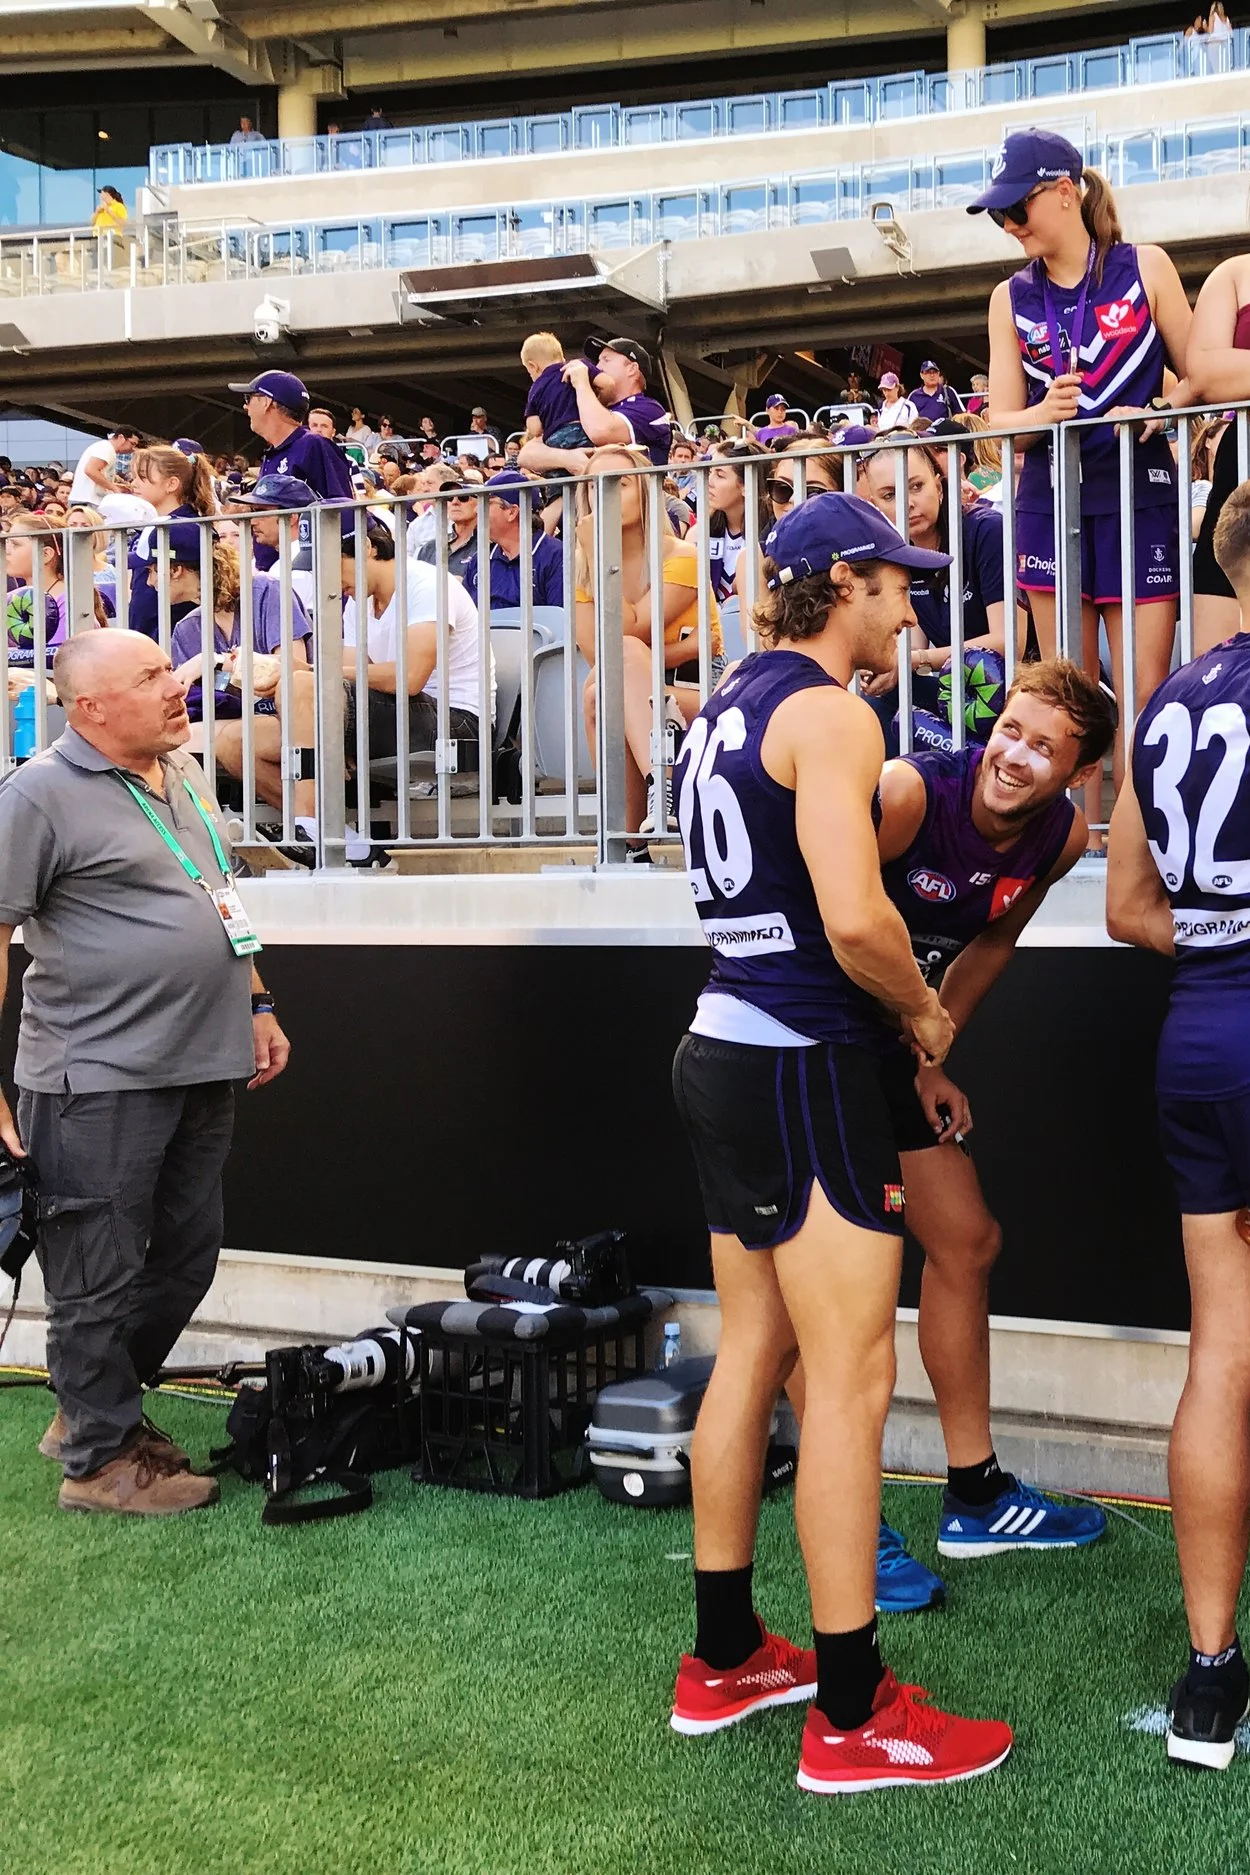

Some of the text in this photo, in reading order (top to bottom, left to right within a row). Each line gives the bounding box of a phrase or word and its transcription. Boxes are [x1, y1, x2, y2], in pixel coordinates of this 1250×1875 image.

[1103, 325, 1137, 339] woodside
[840, 542, 876, 558] PROGRAMMED
[675, 706, 753, 903] 26
[911, 872, 950, 900] AFL
[1213, 876, 1231, 886] AFL
